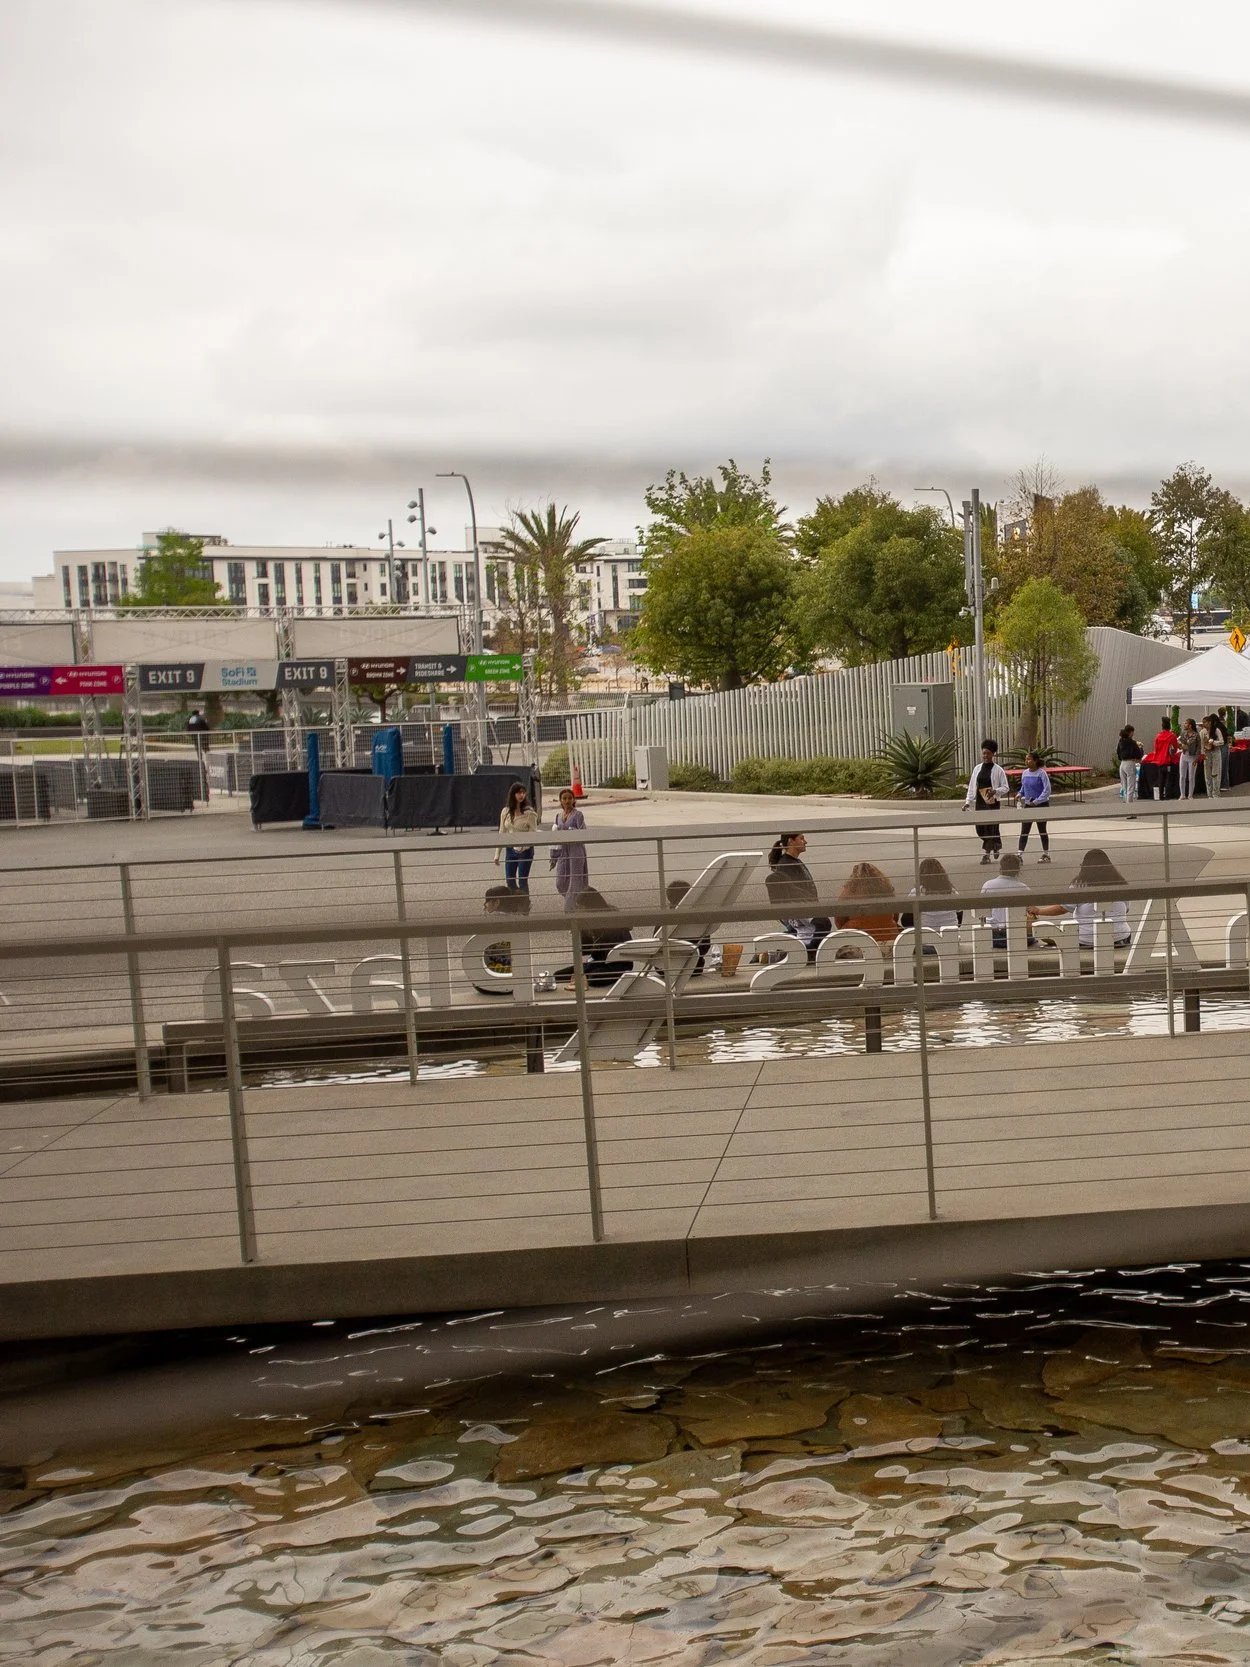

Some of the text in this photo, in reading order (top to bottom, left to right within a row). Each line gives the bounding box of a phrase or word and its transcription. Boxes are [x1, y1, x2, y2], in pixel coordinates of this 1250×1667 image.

[414, 662, 437, 670] TRANSIT
[148, 670, 182, 684] EXIT
[221, 667, 245, 678] SoFi
[285, 667, 316, 681] EXIT
[414, 669, 445, 677] RIDESHARE
[221, 678, 258, 686] Stadium
